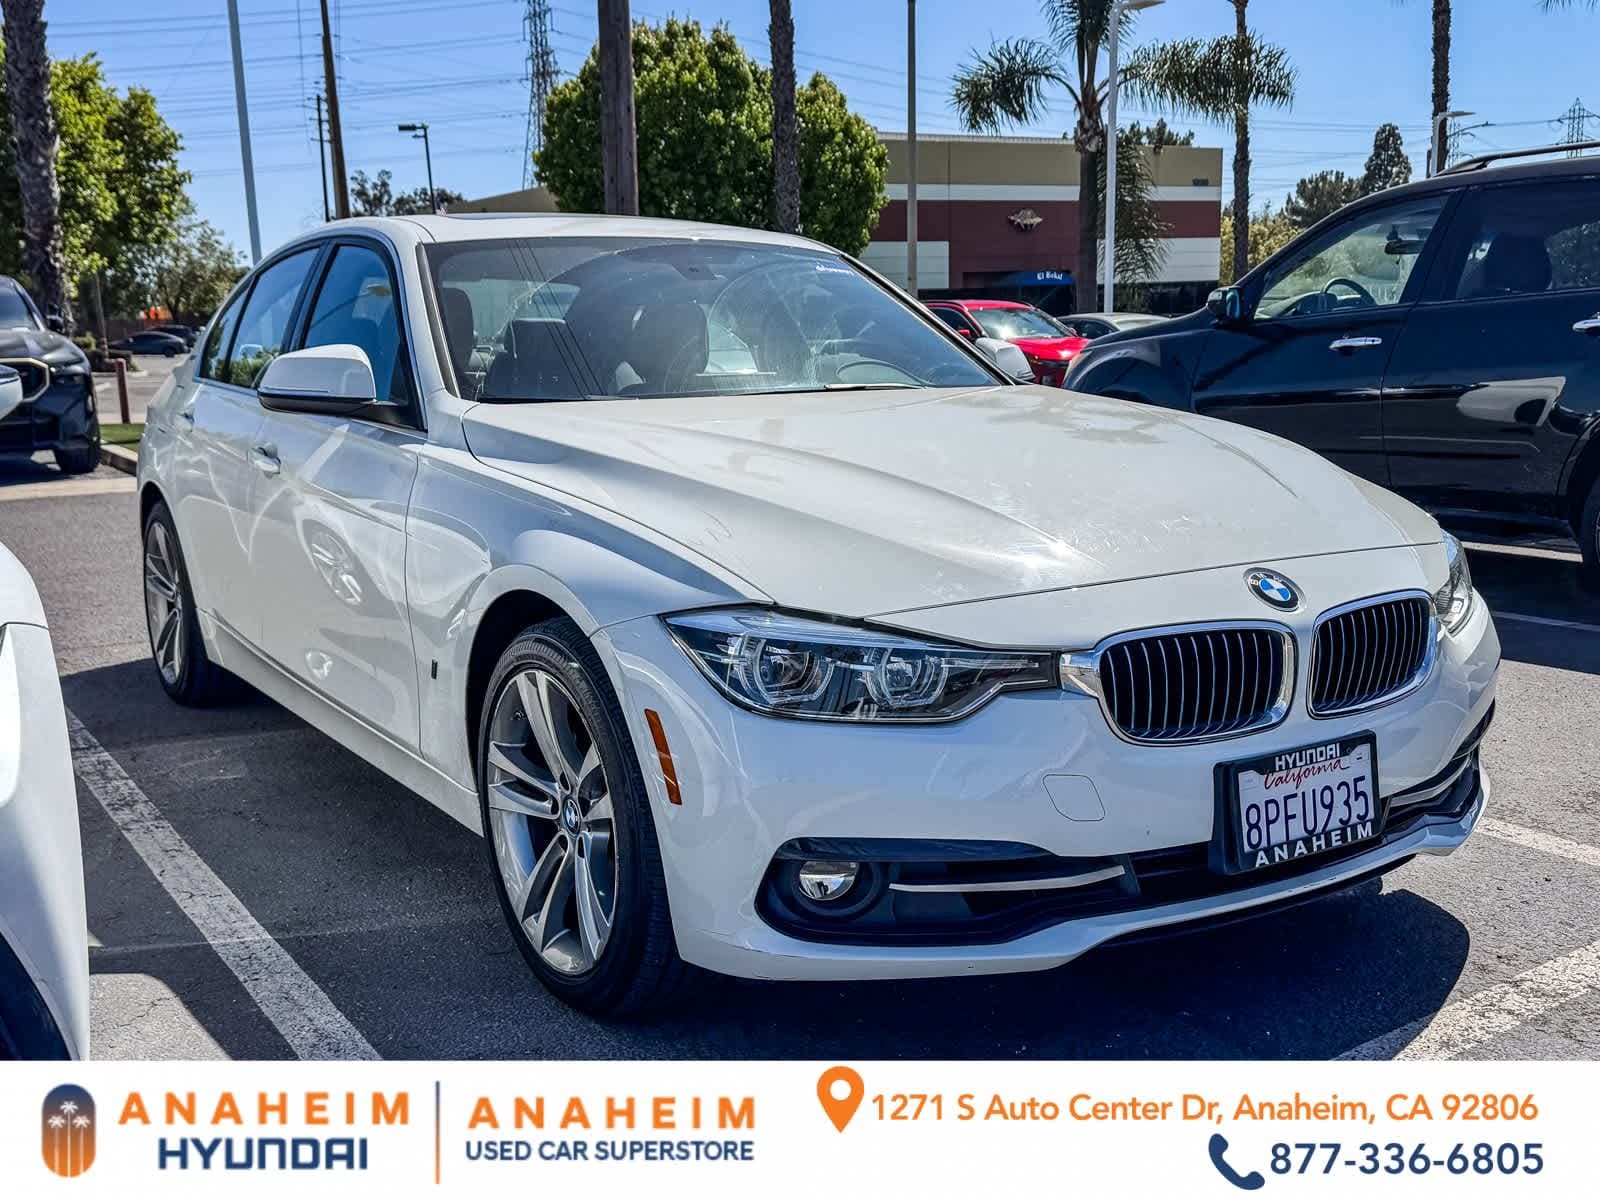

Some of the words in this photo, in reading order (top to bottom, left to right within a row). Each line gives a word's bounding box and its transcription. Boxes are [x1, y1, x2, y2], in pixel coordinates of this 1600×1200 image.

[1264, 758, 1350, 790] California
[1275, 743, 1340, 771] HYUNDAI
[1245, 775, 1369, 850] 8PFU935
[1255, 822, 1373, 868] ANAHEIM
